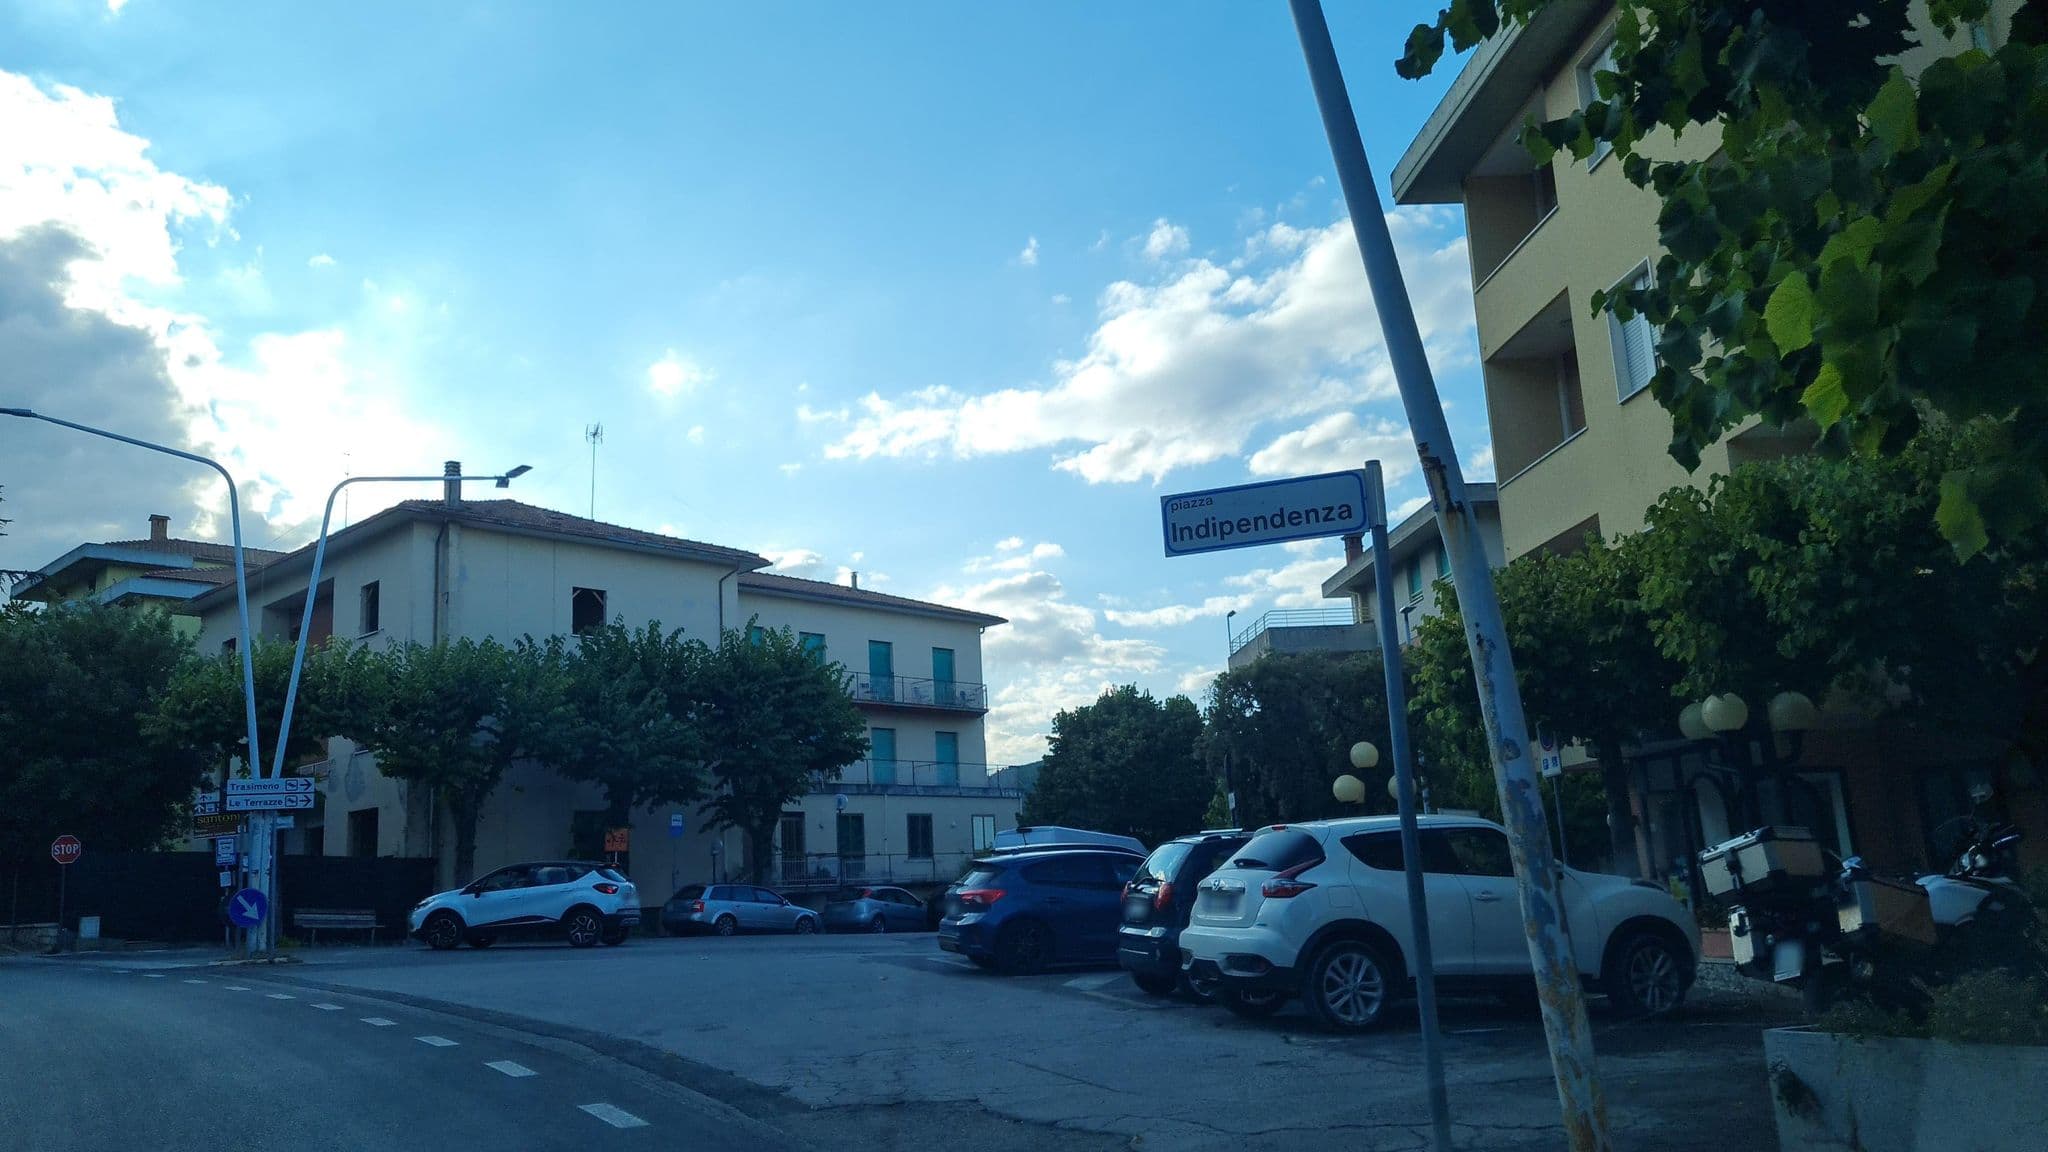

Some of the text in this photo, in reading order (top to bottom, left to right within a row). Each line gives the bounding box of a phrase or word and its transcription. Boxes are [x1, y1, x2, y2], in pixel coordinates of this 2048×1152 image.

[1170, 496, 1213, 513] piazza
[1171, 503, 1353, 542] Indipendenza
[230, 783, 280, 791] Trasimeno
[229, 798, 284, 807] Le Terrazze
[54, 843, 79, 855] STOP
